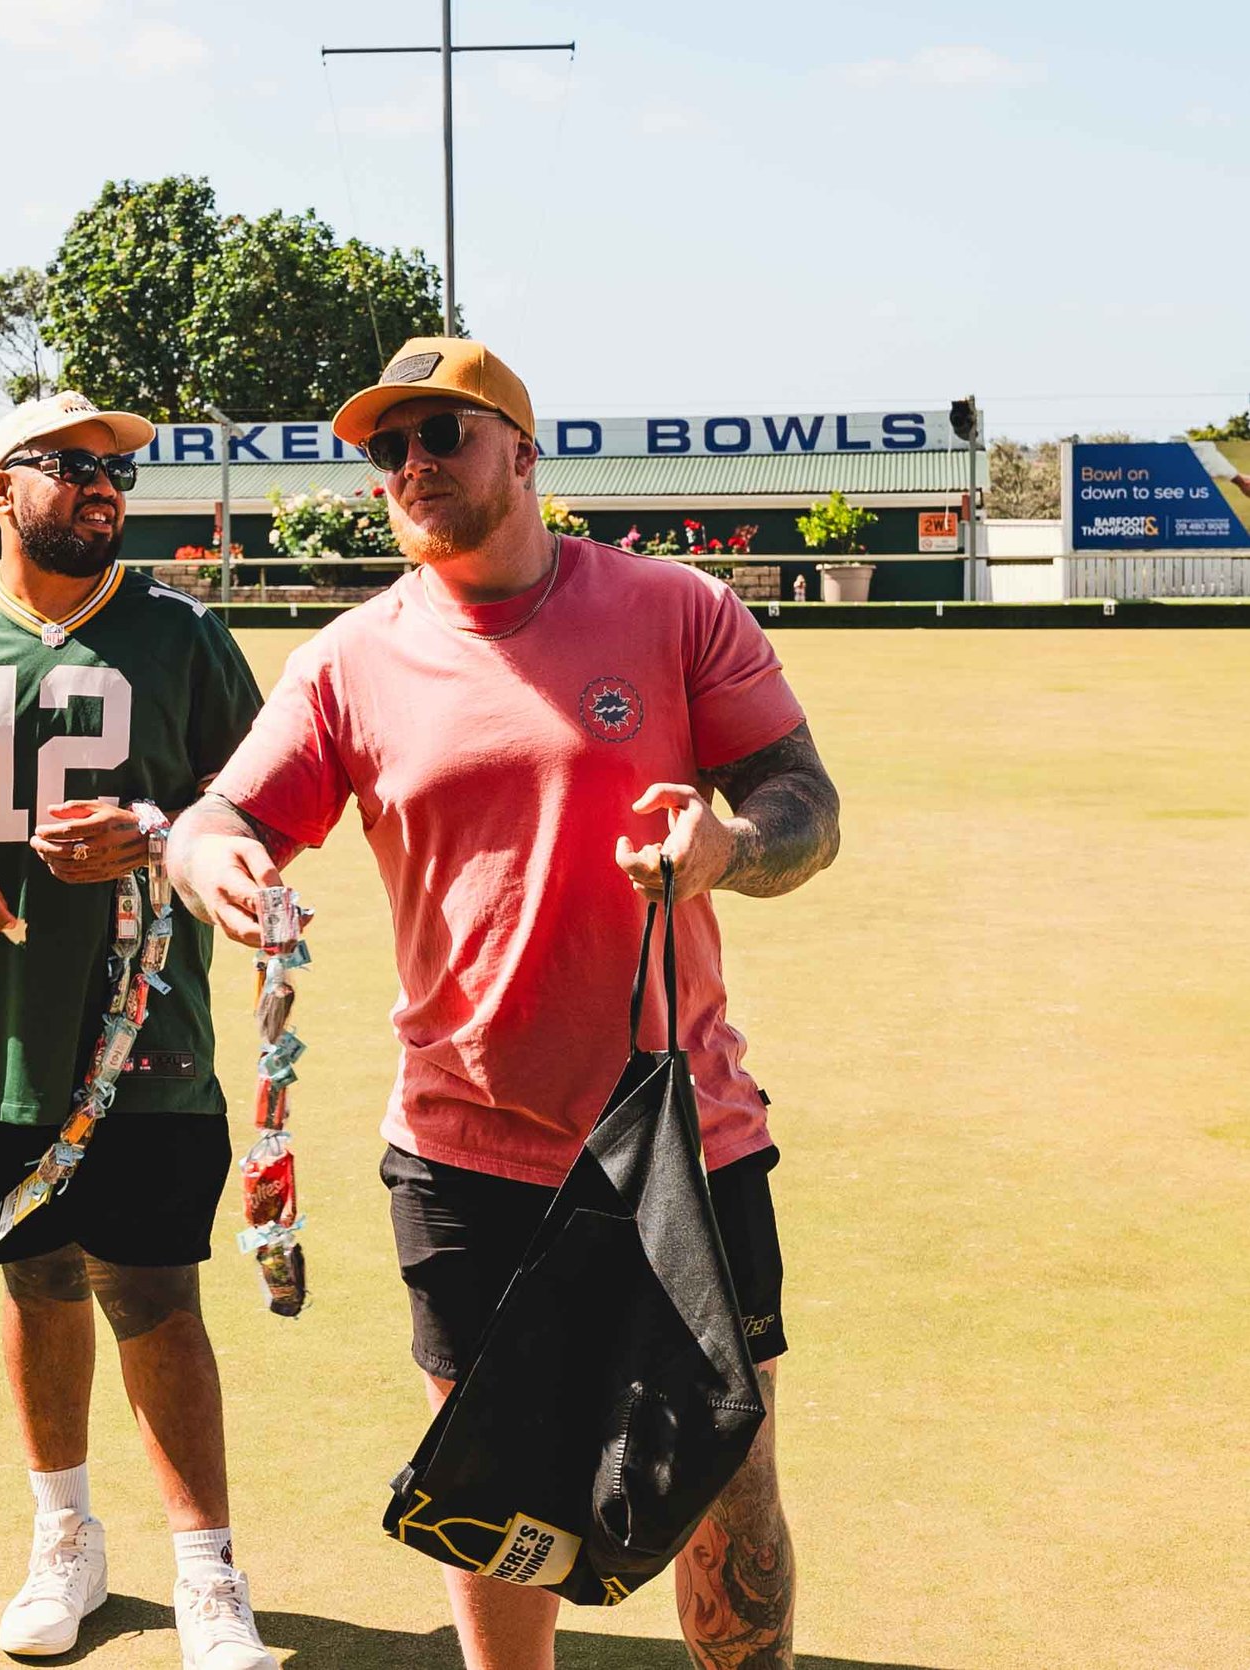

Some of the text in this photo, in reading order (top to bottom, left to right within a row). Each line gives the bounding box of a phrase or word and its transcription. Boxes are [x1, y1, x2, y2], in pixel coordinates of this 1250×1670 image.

[647, 413, 927, 454] BOWLS
[1081, 466, 1149, 482] Bowl on
[1080, 485, 1210, 500] down to see us
[1081, 525, 1145, 536] THOMPSON
[1094, 515, 1159, 536] BARFOOT &
[492, 1525, 539, 1579] HERE'S
